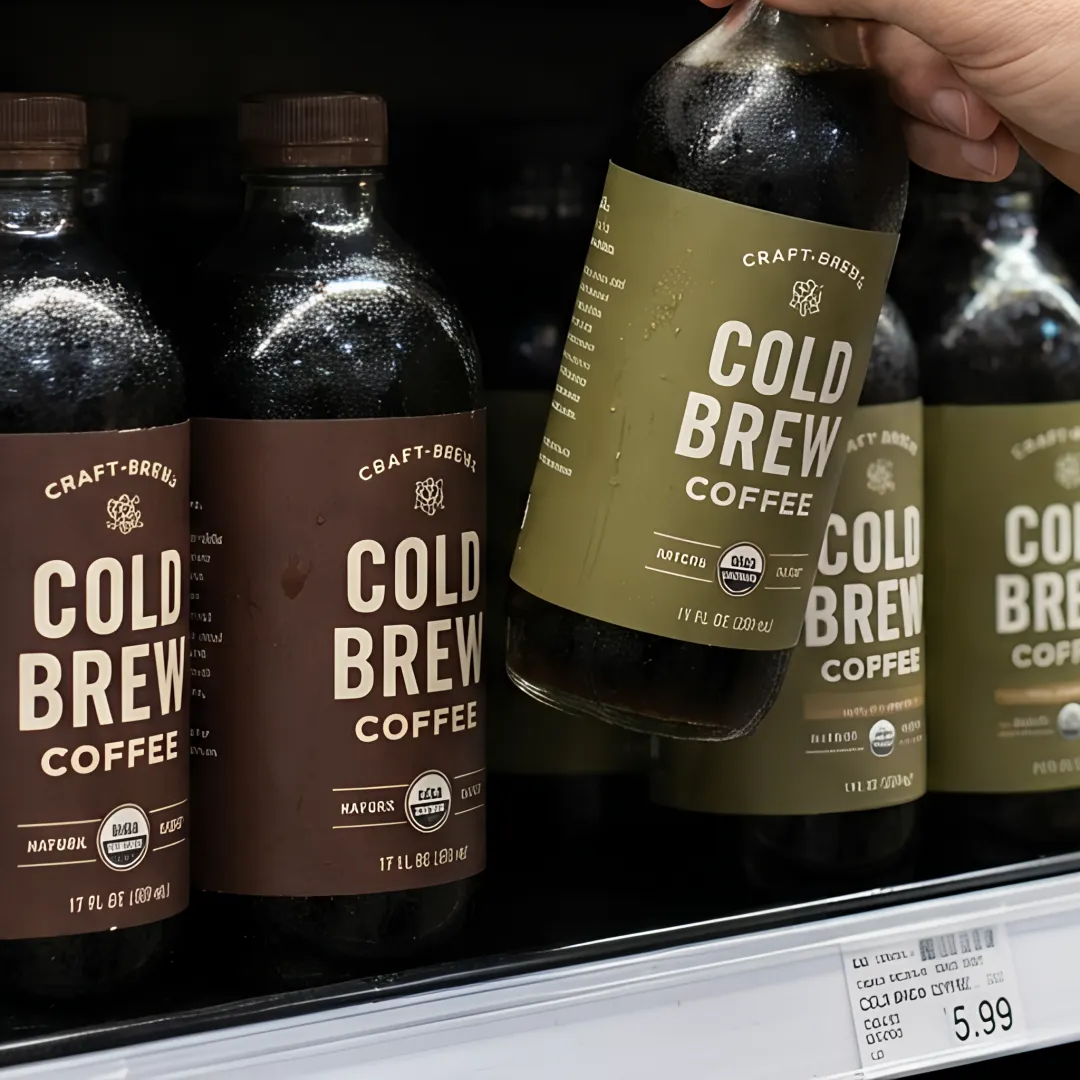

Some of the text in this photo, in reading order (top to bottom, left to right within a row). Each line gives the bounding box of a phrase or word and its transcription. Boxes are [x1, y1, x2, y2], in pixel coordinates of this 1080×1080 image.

[707, 320, 853, 405] COLD
[674, 390, 842, 478] BREW
[684, 475, 814, 517] COFFEE
[346, 530, 480, 614] COLD
[816, 504, 921, 576] COLD
[33, 549, 182, 639] COLD
[804, 572, 924, 649] BREW
[18, 636, 186, 732] BREW
[333, 611, 484, 700] BREW
[40, 730, 178, 777] COFFEE
[355, 700, 478, 743] COFFEE
[953, 996, 1013, 1041] 5.99
